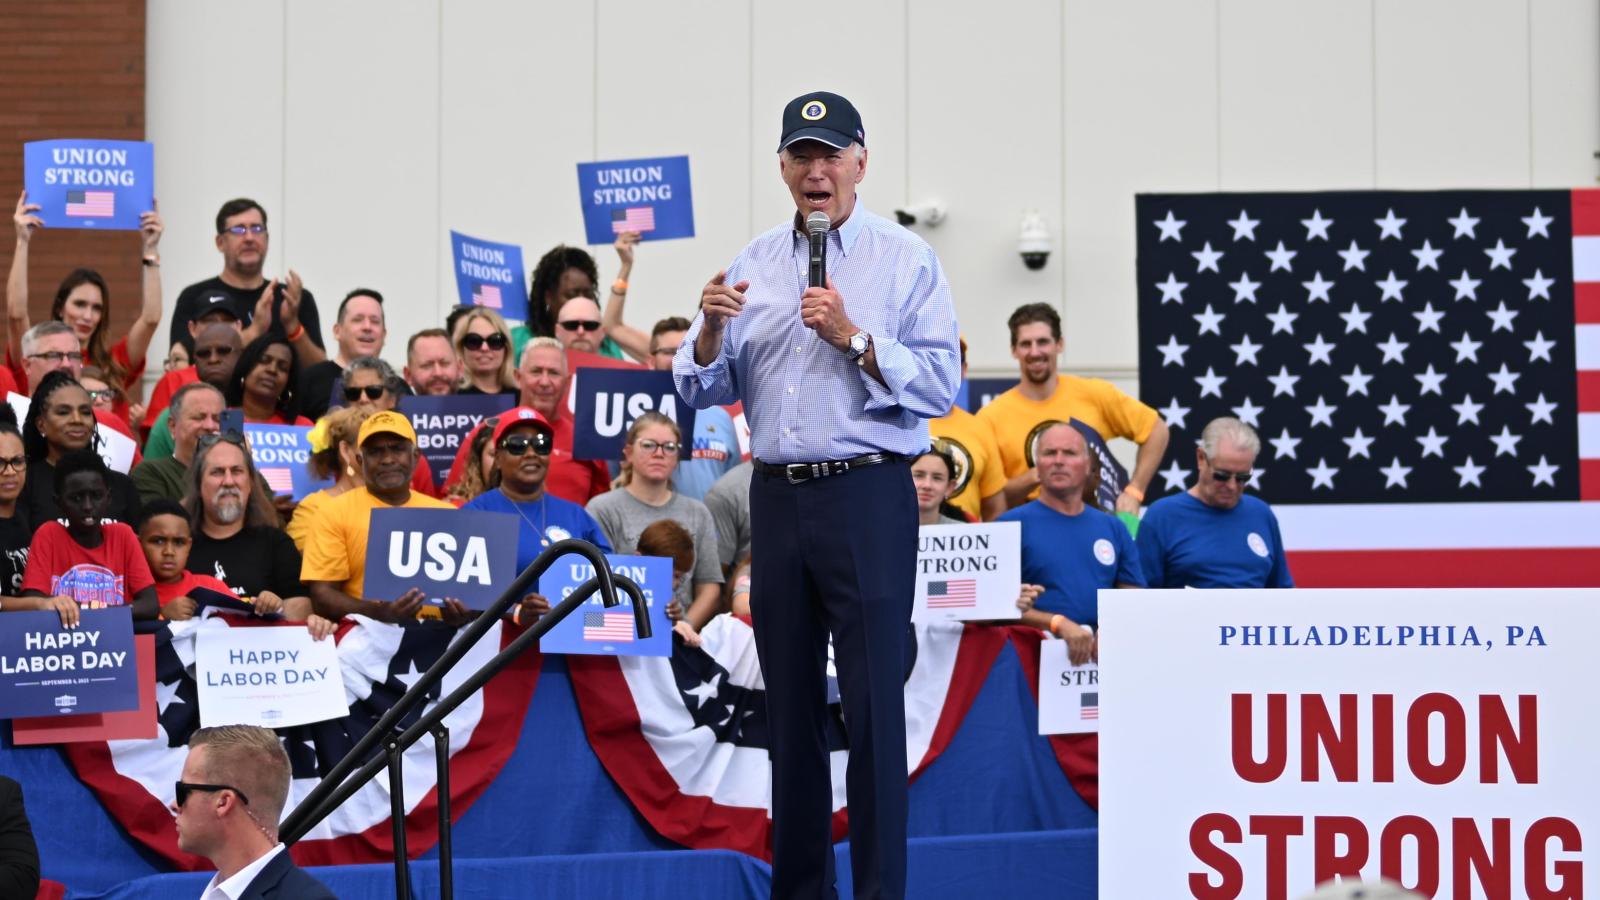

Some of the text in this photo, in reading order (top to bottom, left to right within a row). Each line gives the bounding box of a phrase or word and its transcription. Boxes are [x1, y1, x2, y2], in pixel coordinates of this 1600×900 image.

[53, 148, 127, 166] UNION
[44, 168, 135, 186] STRONG
[597, 166, 663, 186] UNION
[593, 184, 672, 205] STRONG
[462, 242, 504, 265] UNION
[461, 259, 513, 284] STRONG
[413, 413, 483, 429] HAPPY
[246, 431, 298, 447] ION
[417, 434, 459, 449] BOR
[252, 448, 309, 464] RONG
[388, 531, 492, 585] USA
[918, 555, 998, 573] TRONG
[25, 631, 100, 650] HAPPY
[1218, 625, 1547, 651] PHILADELPHIA, PA
[1, 650, 127, 674] LABOR DAY
[229, 649, 300, 665] HAPPY
[206, 667, 328, 686] LABOR DAY
[1060, 670, 1098, 686] STR
[1230, 692, 1539, 785] UNION
[1187, 812, 1584, 900] STRONG
